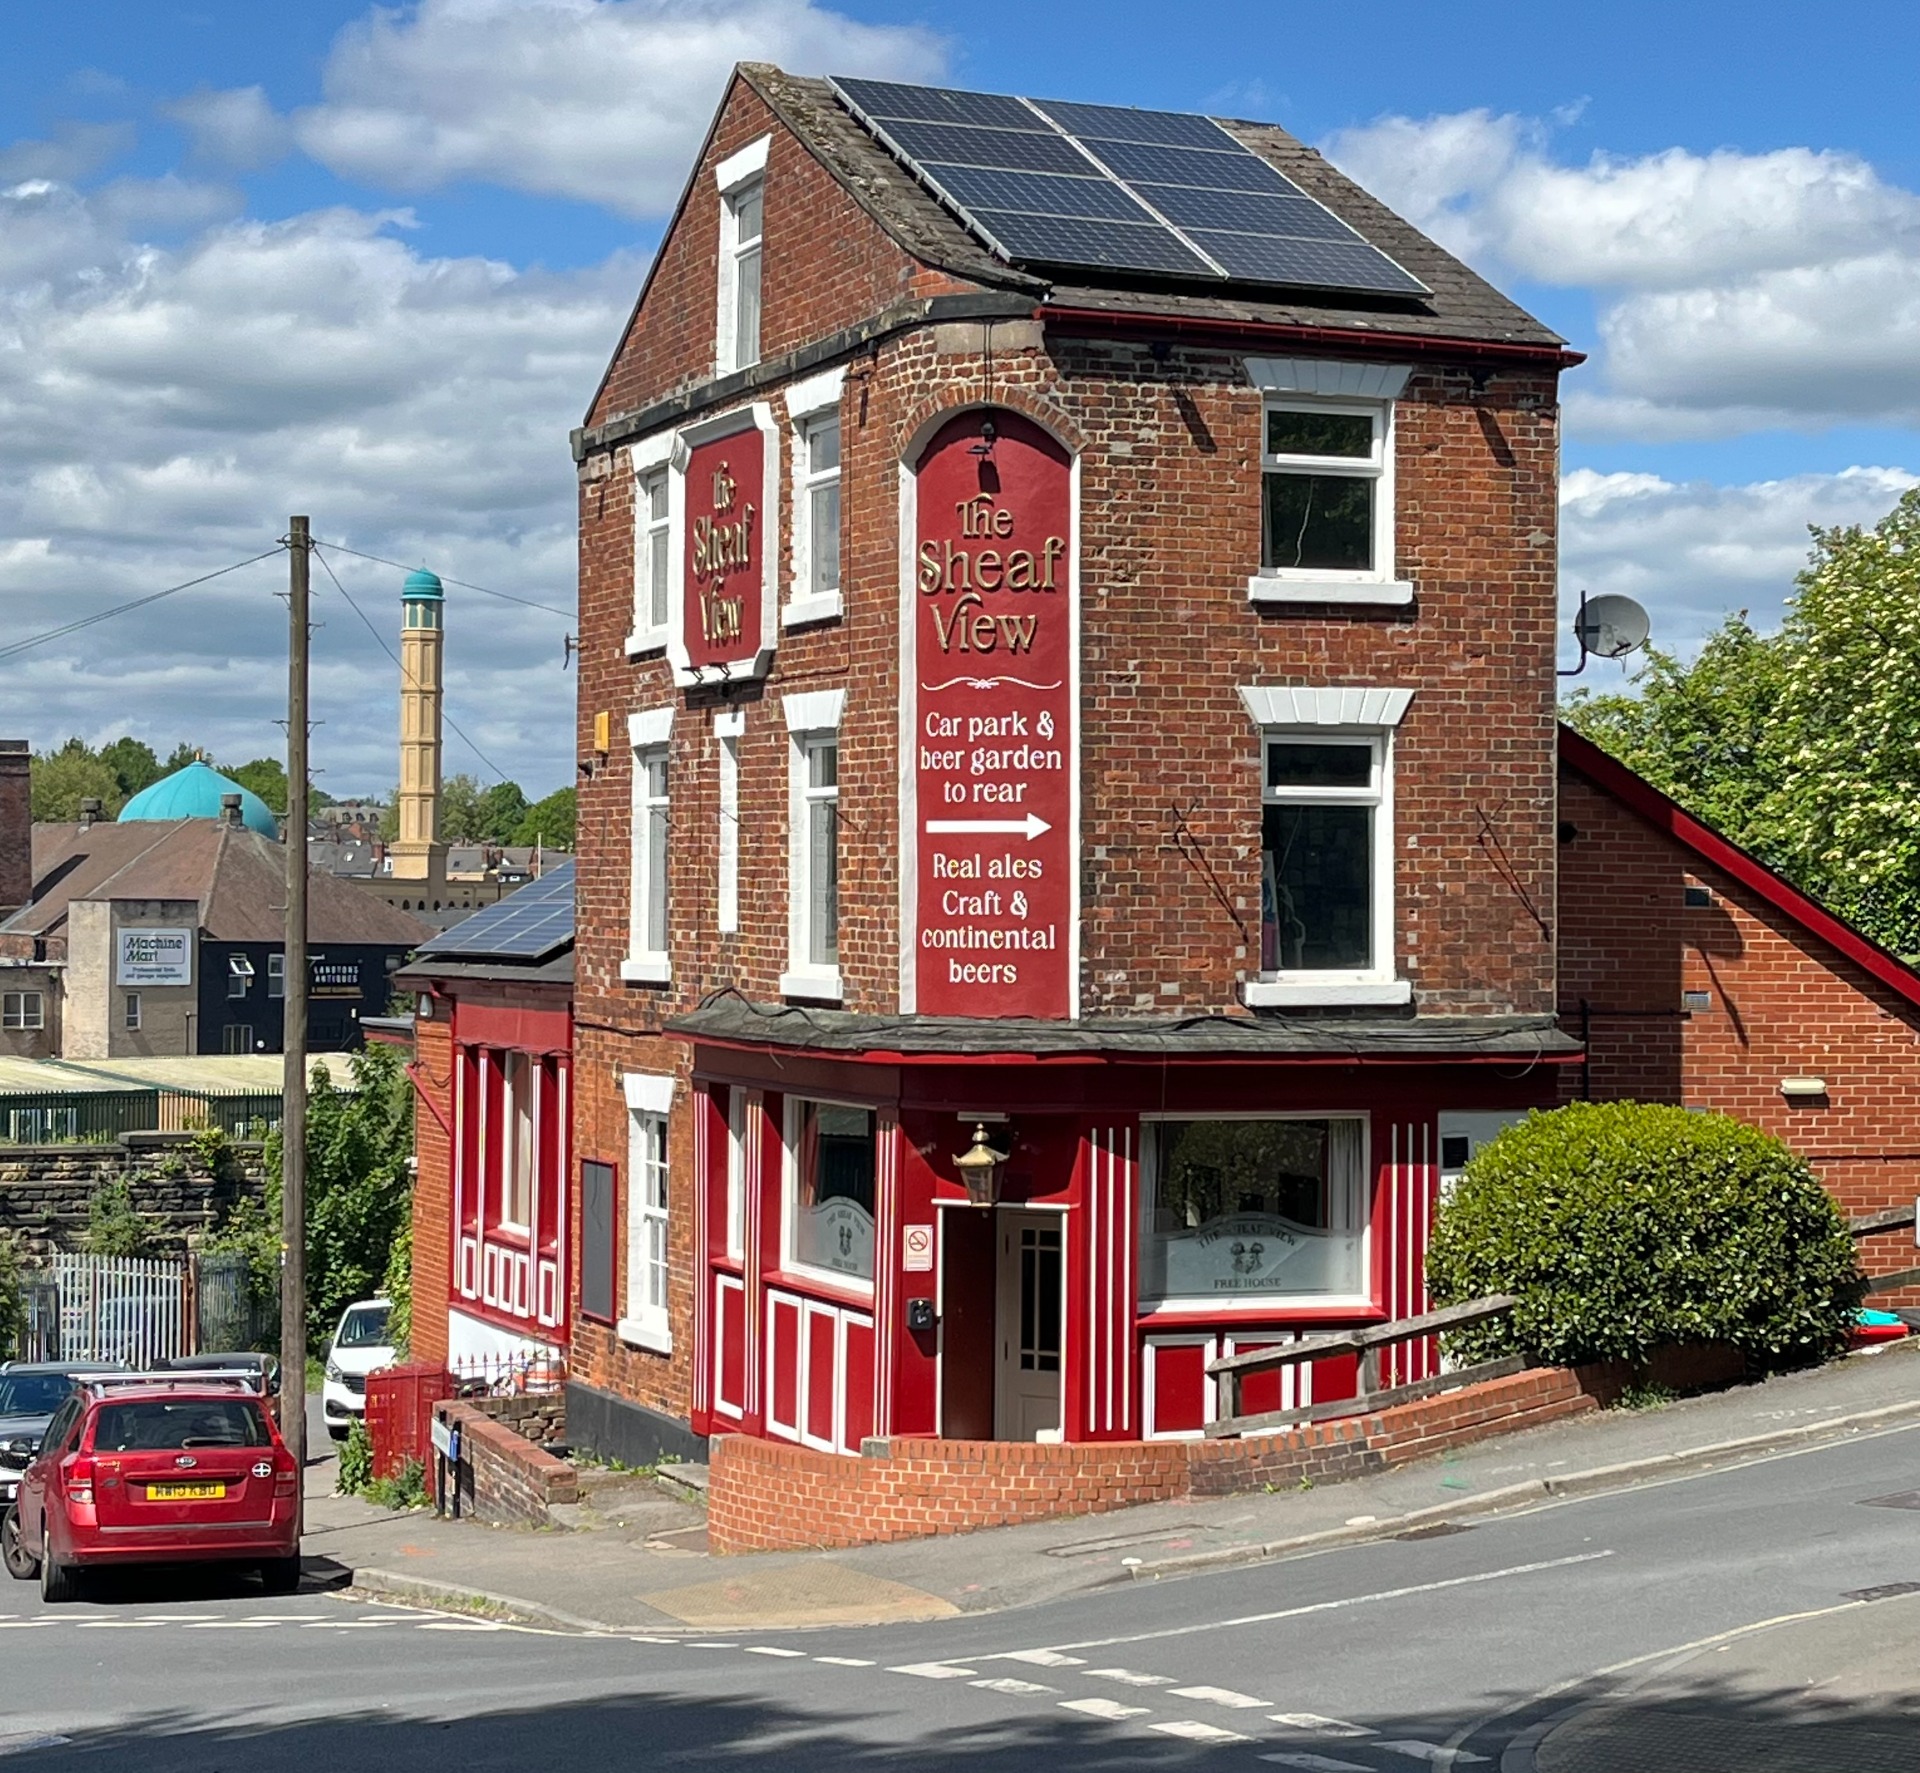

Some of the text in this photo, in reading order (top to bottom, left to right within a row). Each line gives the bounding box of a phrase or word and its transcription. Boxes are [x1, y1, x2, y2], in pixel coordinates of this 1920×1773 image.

[711, 460, 737, 509] The
[955, 492, 1013, 537] The
[693, 503, 755, 575] Sheaf
[918, 536, 1065, 593] Sheaf
[699, 575, 743, 641] View
[929, 592, 1037, 650] View
[925, 710, 1054, 742] Car park &
[920, 744, 1062, 776] beer garden
[943, 780, 1027, 803] to rear
[933, 853, 1042, 879] Real ales
[942, 890, 1028, 920] Craft &
[125, 937, 183, 949] Machine
[921, 924, 1056, 950] continental
[125, 950, 158, 962] Mart
[949, 958, 1017, 984] beers
[1214, 1278, 1282, 1289] FREE HOUSE
